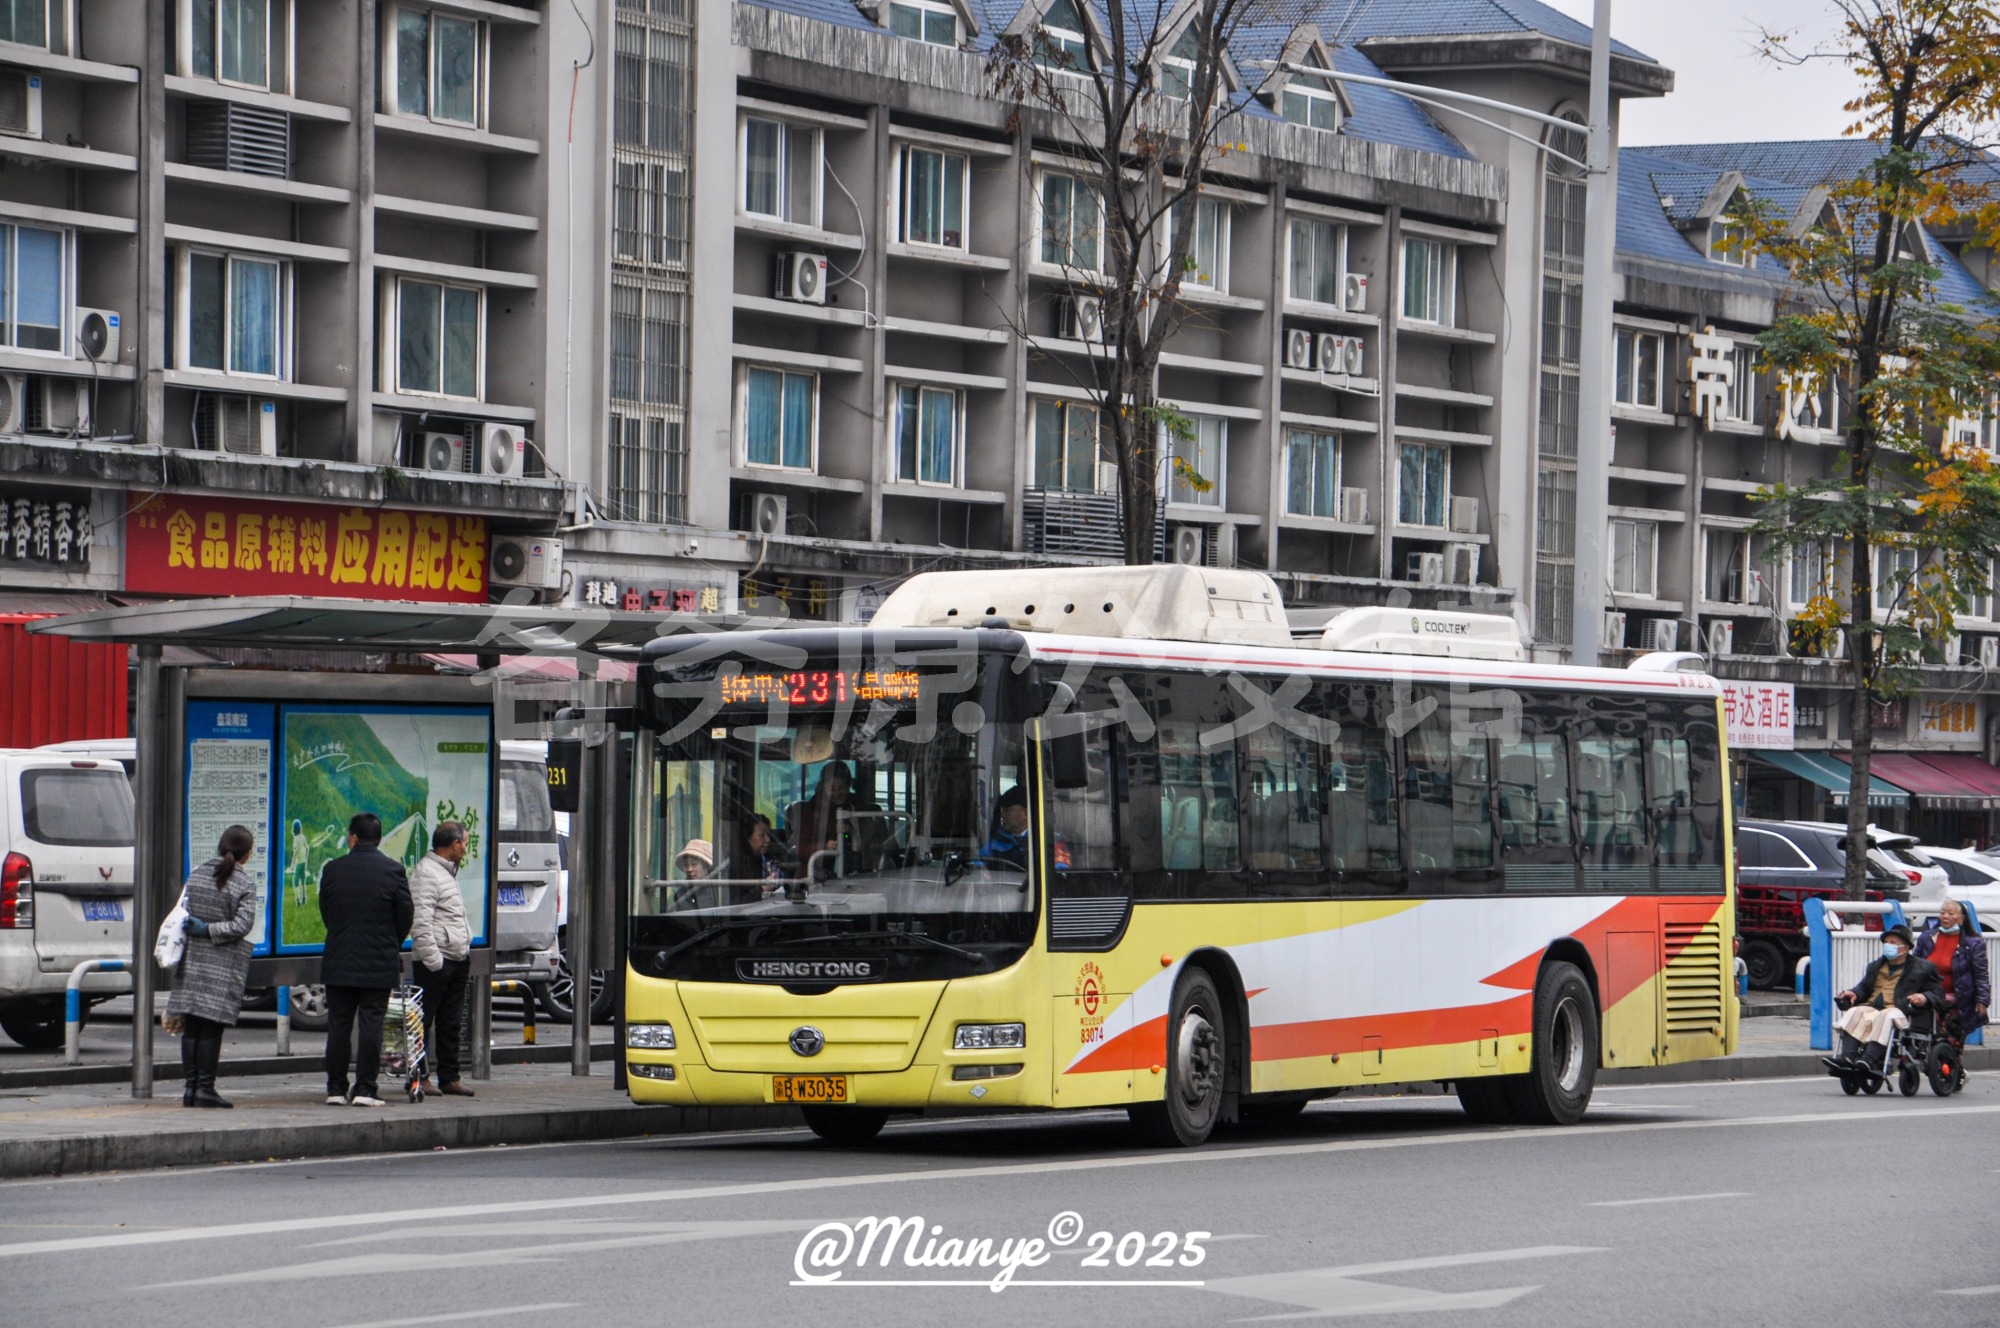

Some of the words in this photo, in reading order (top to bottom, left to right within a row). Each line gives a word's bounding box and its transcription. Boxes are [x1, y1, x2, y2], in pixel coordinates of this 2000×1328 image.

[166, 507, 488, 594] 食品原辅料应用配送
[743, 577, 827, 616] 电子秤
[1424, 621, 1467, 635] COOLTEK
[789, 671, 847, 703] 231
[1723, 685, 1790, 729] 帝达酒店
[547, 766, 567, 786] 231
[753, 961, 871, 977] HENGTONG
[1080, 1026, 1104, 1044] 83074
